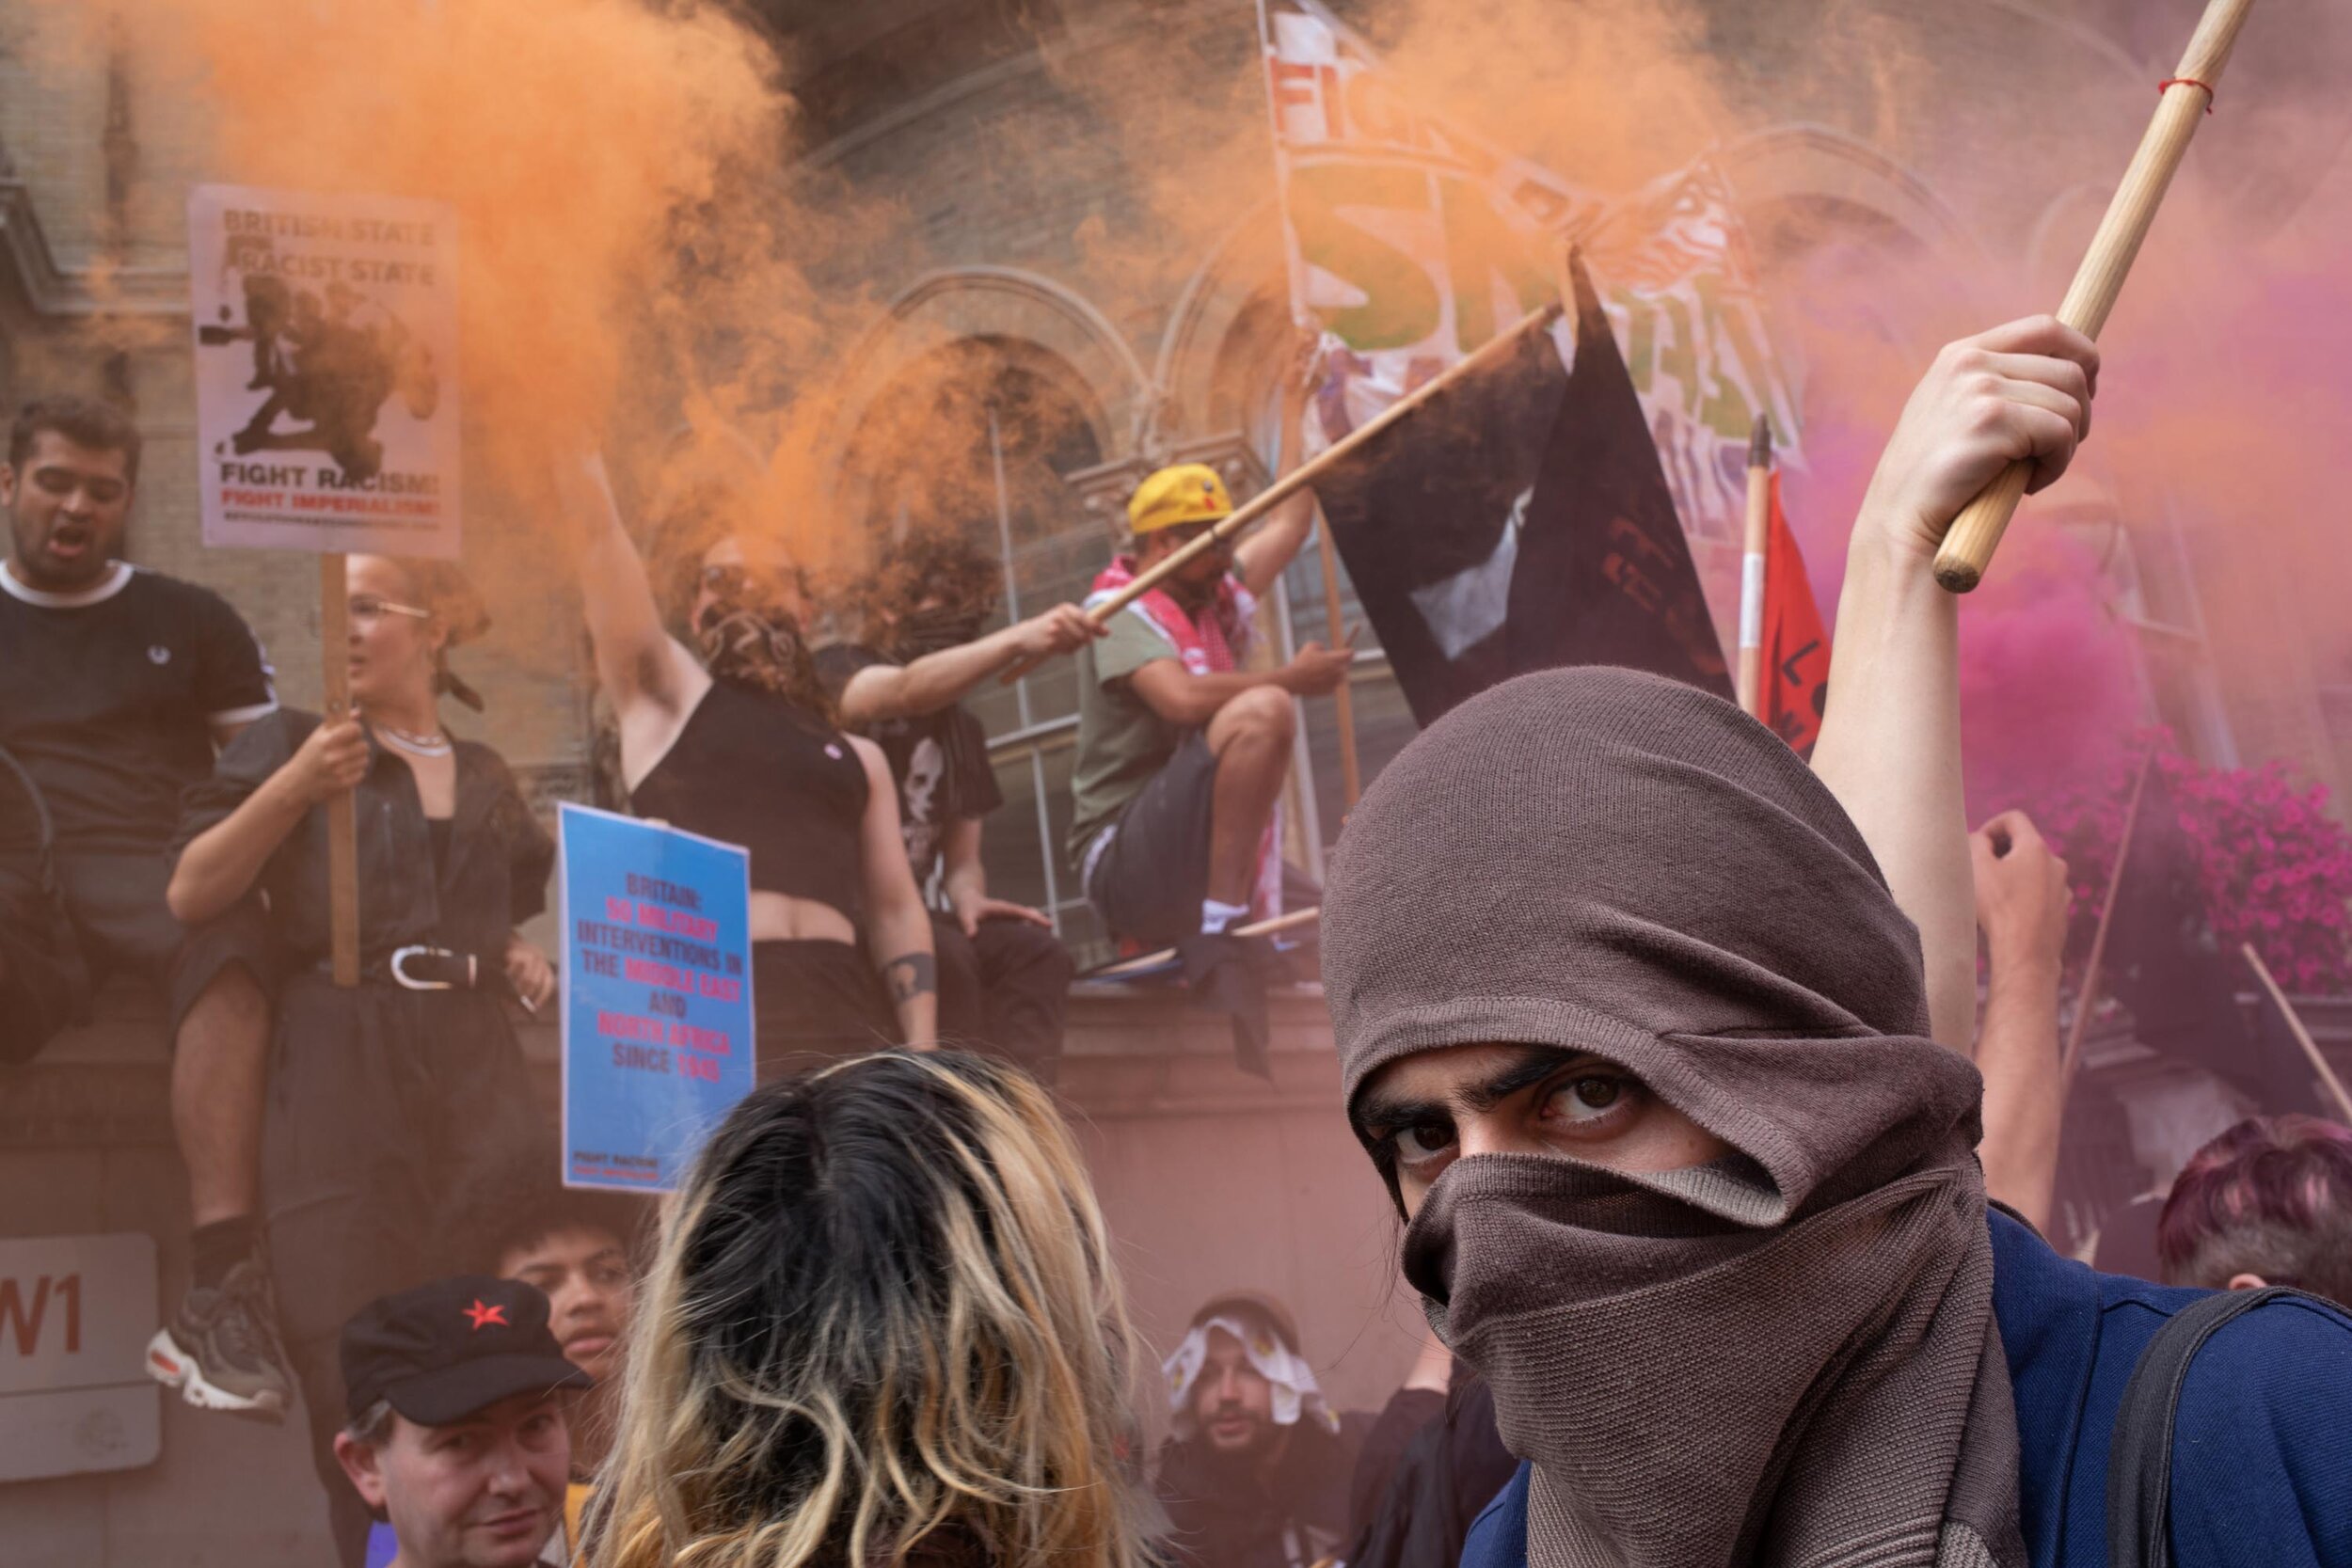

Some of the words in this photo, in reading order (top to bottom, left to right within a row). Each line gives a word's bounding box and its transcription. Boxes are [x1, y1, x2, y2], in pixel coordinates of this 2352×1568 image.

[224, 209, 343, 238] BRITISH
[351, 219, 437, 245] STATE
[240, 250, 342, 278] RACIST
[350, 259, 437, 285] STATE
[220, 463, 307, 488] FIGHT
[318, 467, 440, 496] RACISM!
[221, 489, 285, 508] FIGHT
[638, 902, 719, 943] MILITARY
[578, 918, 721, 972] INTERVENTIONS
[725, 951, 743, 976] IN
[581, 948, 620, 978] THE
[625, 957, 693, 994] MIDDLE
[700, 973, 741, 1004] EAST
[648, 990, 687, 1020] AND
[597, 1009, 664, 1044] NORTH
[669, 1022, 732, 1056] AFRICA
[613, 1043, 671, 1074] SINCE
